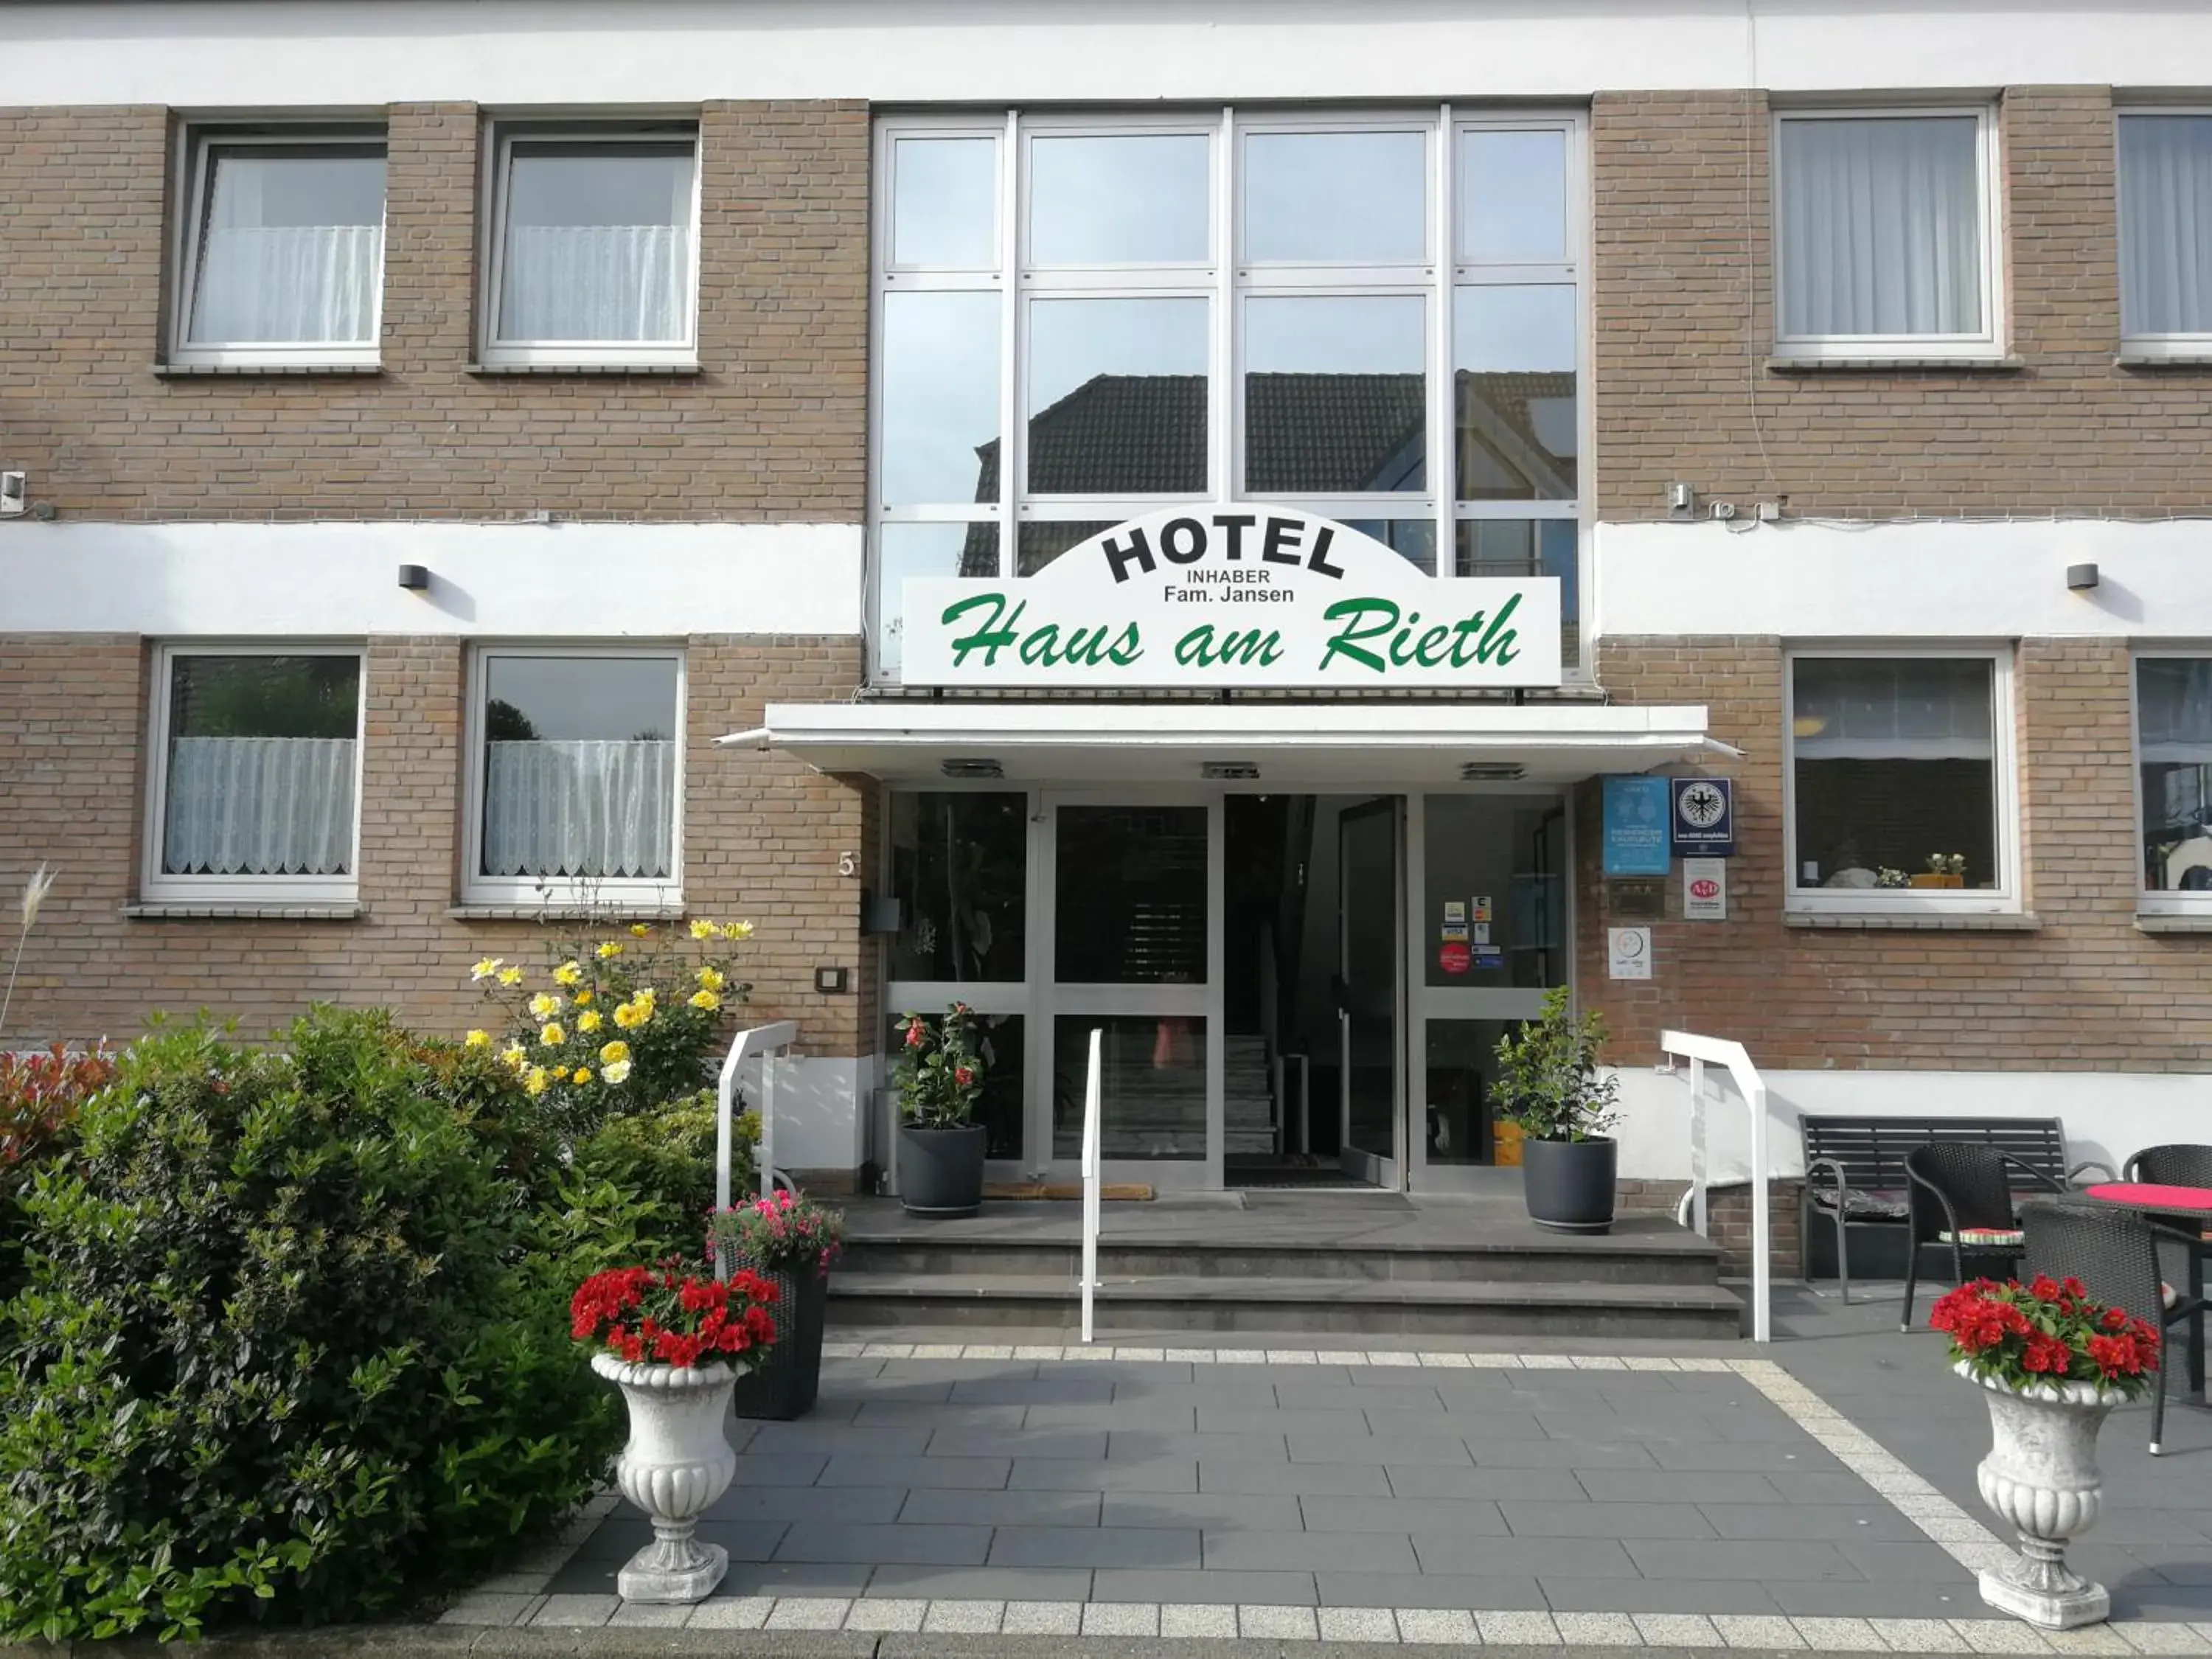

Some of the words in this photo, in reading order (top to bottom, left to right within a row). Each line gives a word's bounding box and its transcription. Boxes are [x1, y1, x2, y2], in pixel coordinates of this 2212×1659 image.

[1102, 515, 1345, 583] HOTEL
[1186, 570, 1270, 583] INHABER
[1164, 585, 1214, 602] Fam.
[1220, 585, 1295, 602] Jansen
[942, 592, 1144, 667] Haus
[1175, 625, 1284, 667] am
[1318, 593, 1523, 673] Rieth
[838, 851, 854, 875] 5
